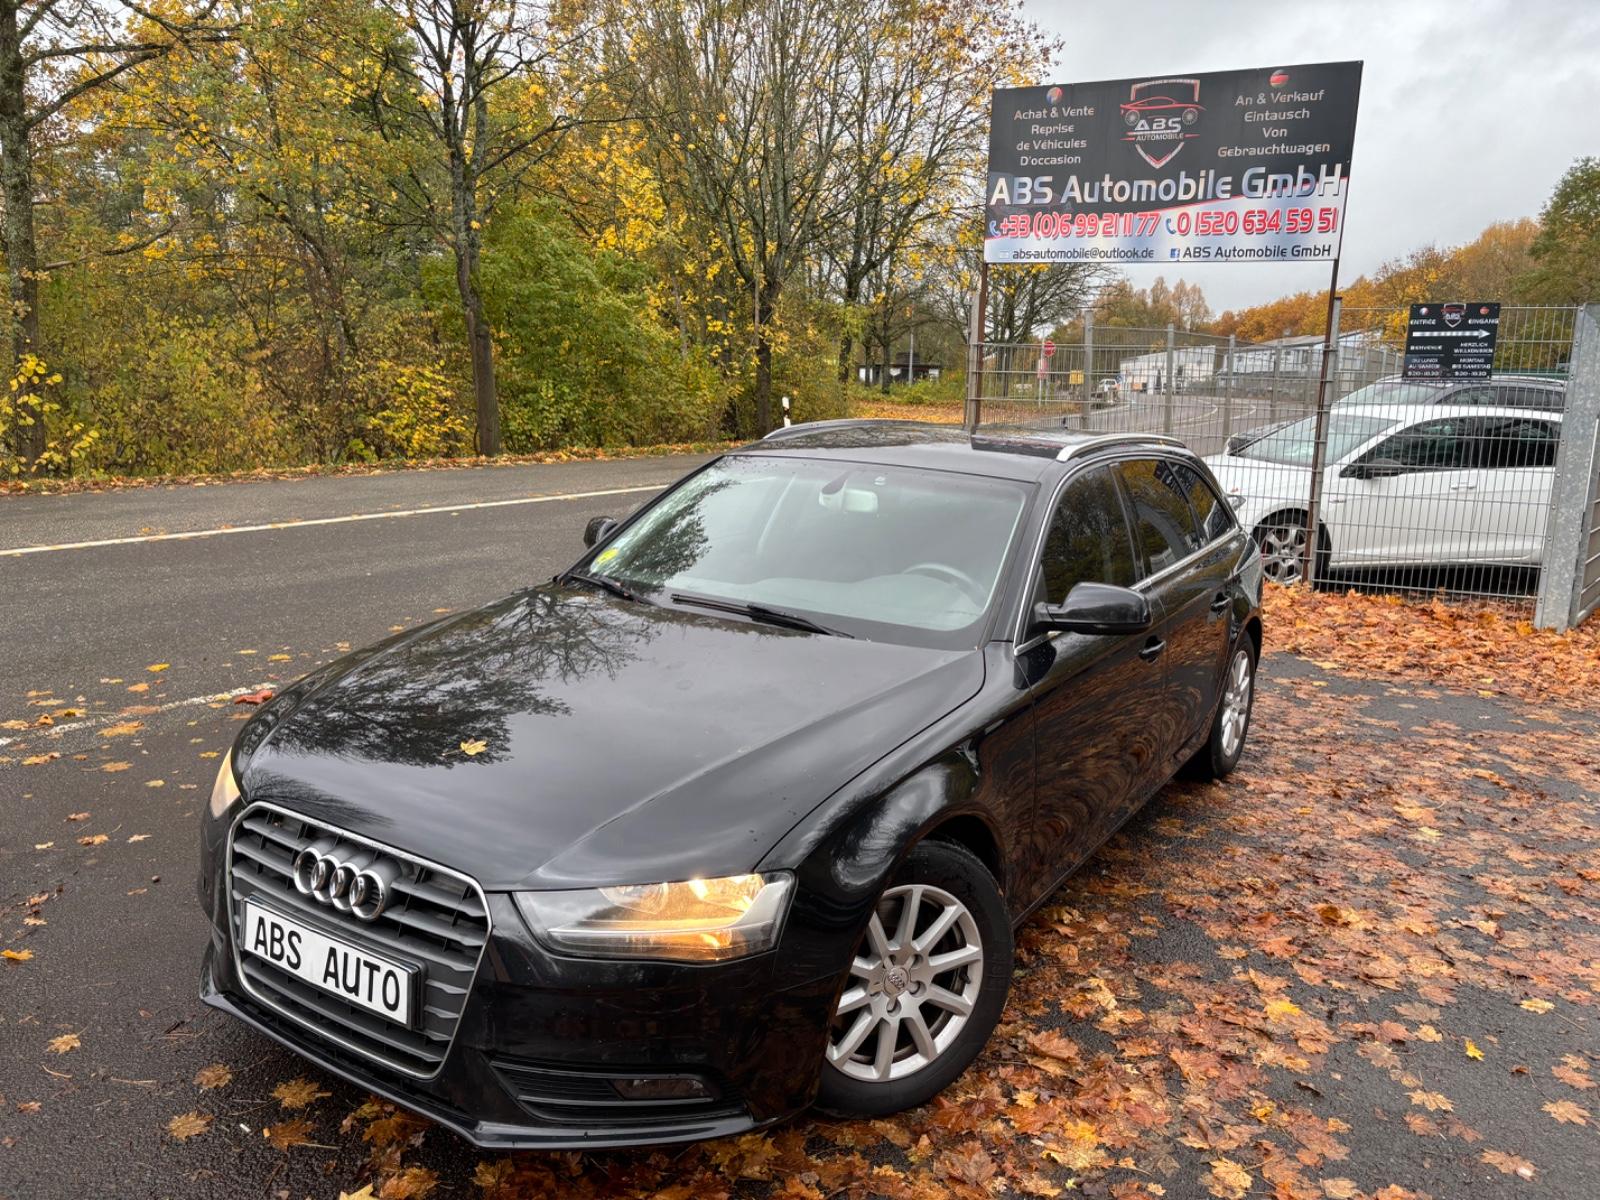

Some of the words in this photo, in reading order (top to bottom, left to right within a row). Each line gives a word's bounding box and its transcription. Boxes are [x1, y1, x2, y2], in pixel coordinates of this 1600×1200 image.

[1235, 95, 1253, 106] An
[1256, 92, 1267, 105] &
[1270, 89, 1325, 104] Verkauf
[1013, 108, 1048, 120] Achat
[1050, 106, 1059, 118] &
[1062, 105, 1095, 117] Vente
[1244, 108, 1310, 122] Eintausch
[1031, 123, 1075, 136] Reprise
[1134, 117, 1182, 133] ABS
[1135, 133, 1184, 141] AUTOMOBILE
[1262, 127, 1288, 138] Von
[1016, 141, 1030, 151] de
[1032, 139, 1087, 150] Véhicules
[1217, 143, 1330, 157] Gebrauchtwagen
[1020, 154, 1081, 166] D'occasion
[989, 175, 1053, 206] ABS
[1060, 168, 1233, 204] Automobile
[1241, 163, 1342, 199] GmbH
[1000, 214, 1031, 238] +33
[1032, 211, 1071, 240] (0)6
[1074, 213, 1099, 237] 99
[1101, 212, 1119, 237] 21
[1123, 212, 1134, 236] 11
[1136, 212, 1161, 236] 77
[1177, 211, 1191, 236] 0
[1194, 210, 1238, 236] 1520
[1242, 209, 1281, 235] 634
[1285, 207, 1313, 233] 59
[1317, 206, 1338, 233] 51
[1012, 247, 1154, 260] abs-automobile@outlook.de
[1183, 246, 1211, 259] ABS
[1214, 244, 1287, 258] Automobile
[1291, 244, 1331, 257] GmbH
[253, 916, 302, 971] ABS
[323, 946, 401, 1012] AUTO
